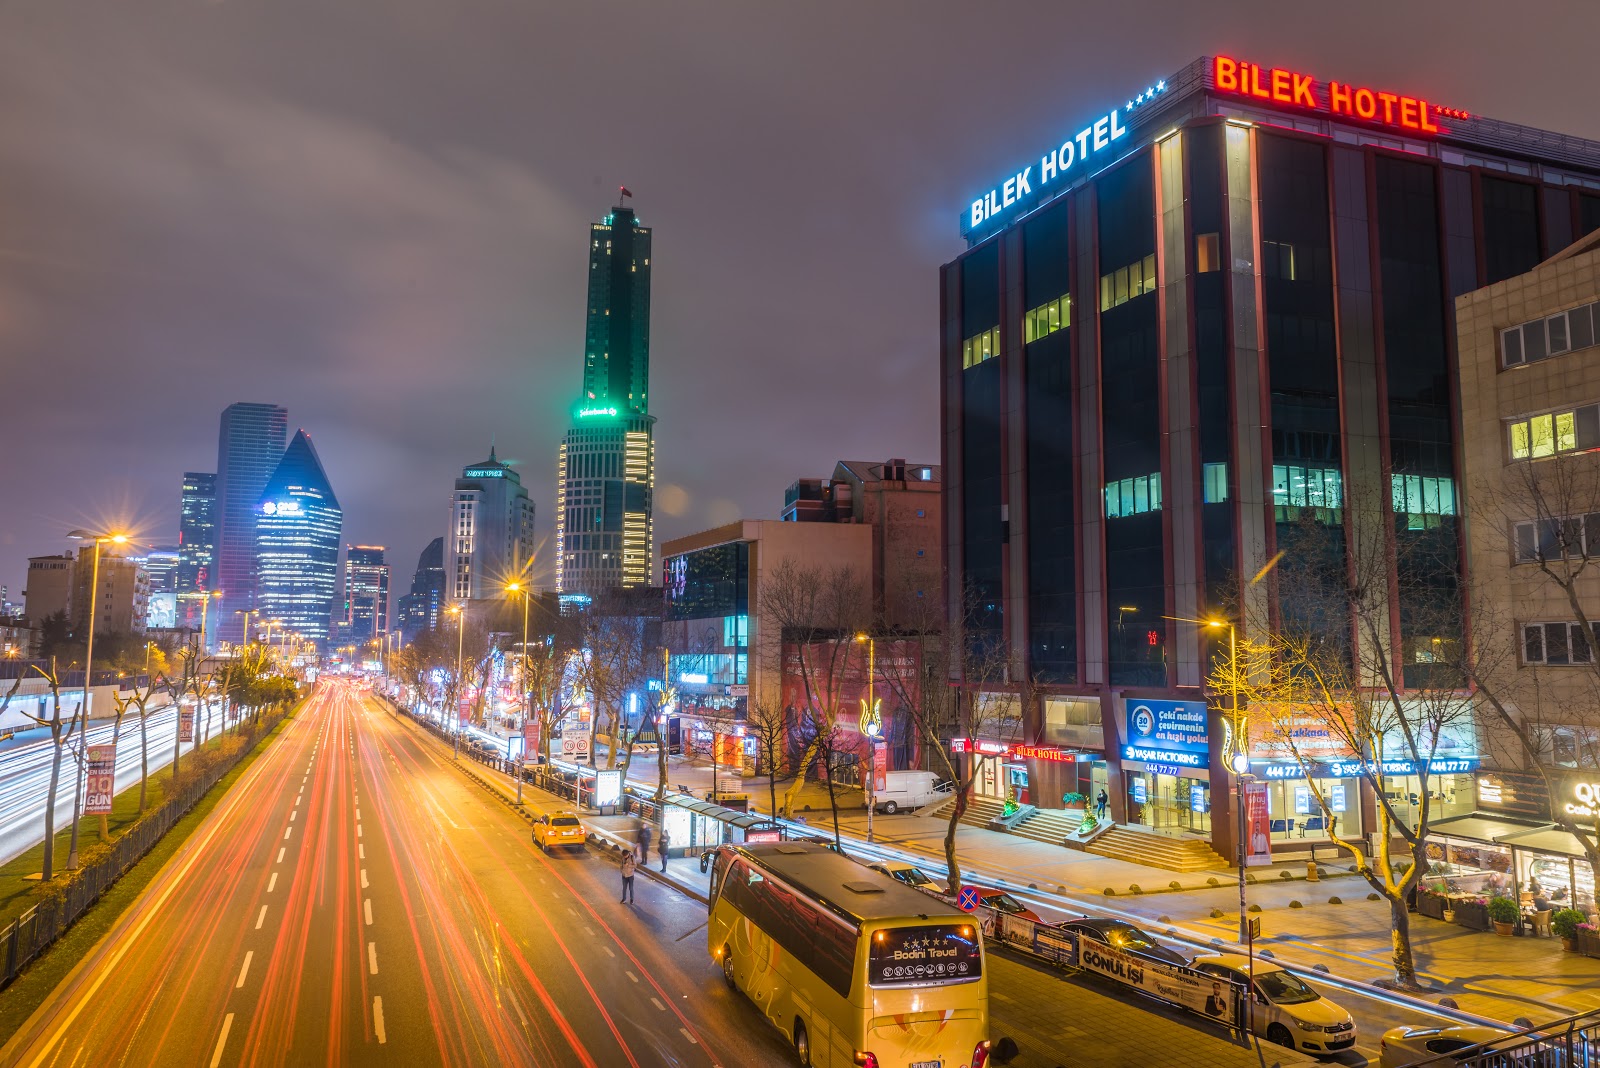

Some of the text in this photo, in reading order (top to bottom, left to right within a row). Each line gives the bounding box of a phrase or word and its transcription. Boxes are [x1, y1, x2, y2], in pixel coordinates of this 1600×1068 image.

[1329, 80, 1437, 134] HOTEL
[1041, 109, 1126, 185] HOTEL
[1158, 711, 1203, 722] Çeki nakde
[1158, 723, 1204, 733] çevirmenin
[1037, 749, 1062, 761] HOTEL
[1134, 748, 1199, 765] YAŞAR FACTORING
[1145, 763, 1178, 775] 444 77 77
[1266, 766, 1284, 776] 444
[1284, 766, 1297, 776] 77
[1430, 760, 1469, 771] 444 77 77
[89, 777, 112, 794] 10
[87, 793, 111, 806] GÜN
[894, 946, 957, 961] Bodini Travel
[1082, 949, 1128, 979] GÖNÜL
[1127, 963, 1146, 985] İŞİ
